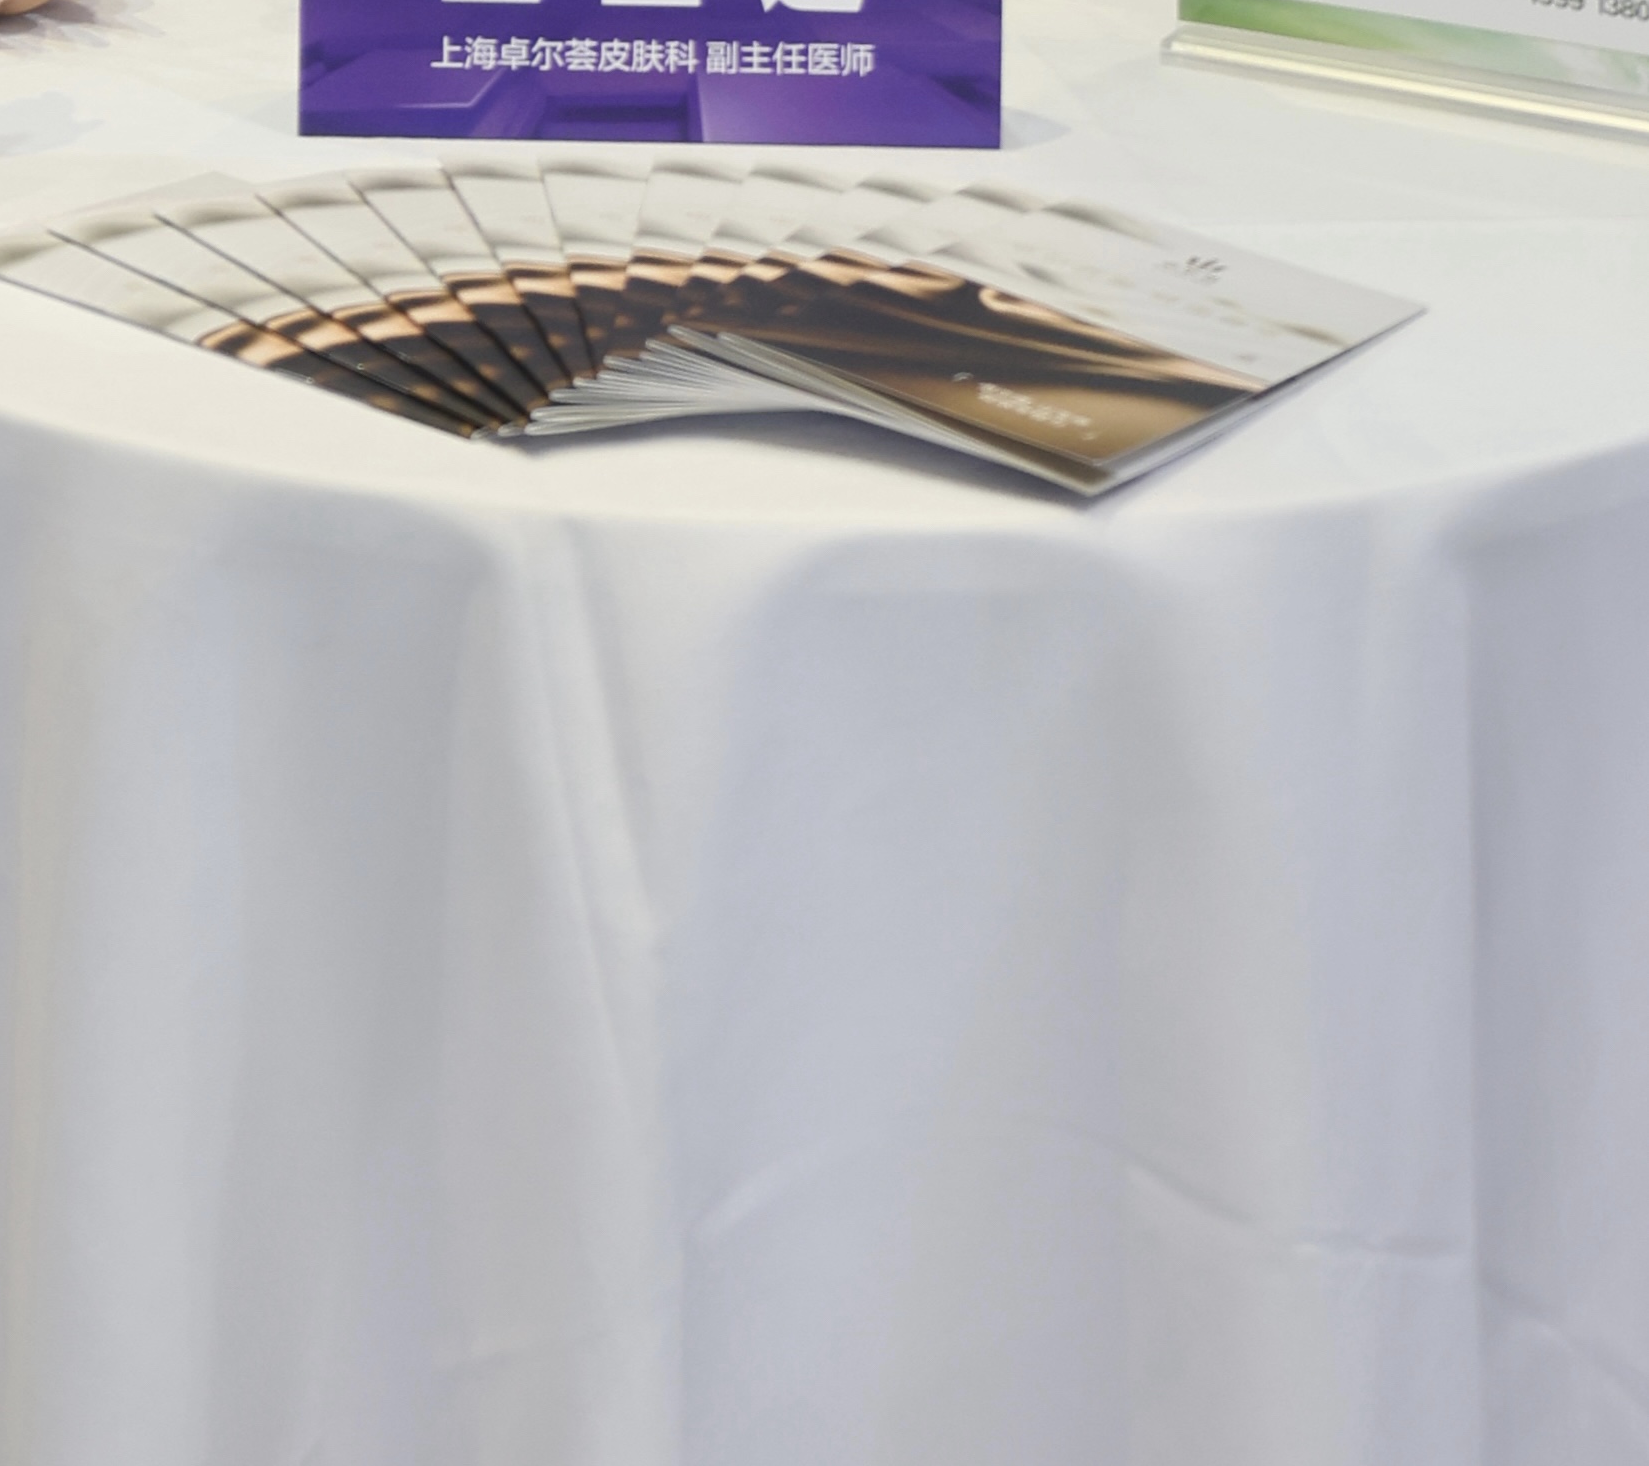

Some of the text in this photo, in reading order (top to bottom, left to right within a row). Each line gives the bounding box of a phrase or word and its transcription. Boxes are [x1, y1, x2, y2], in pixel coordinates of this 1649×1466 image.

[431, 34, 875, 78] 上海卓尔荟皮肤科 副主任医师
